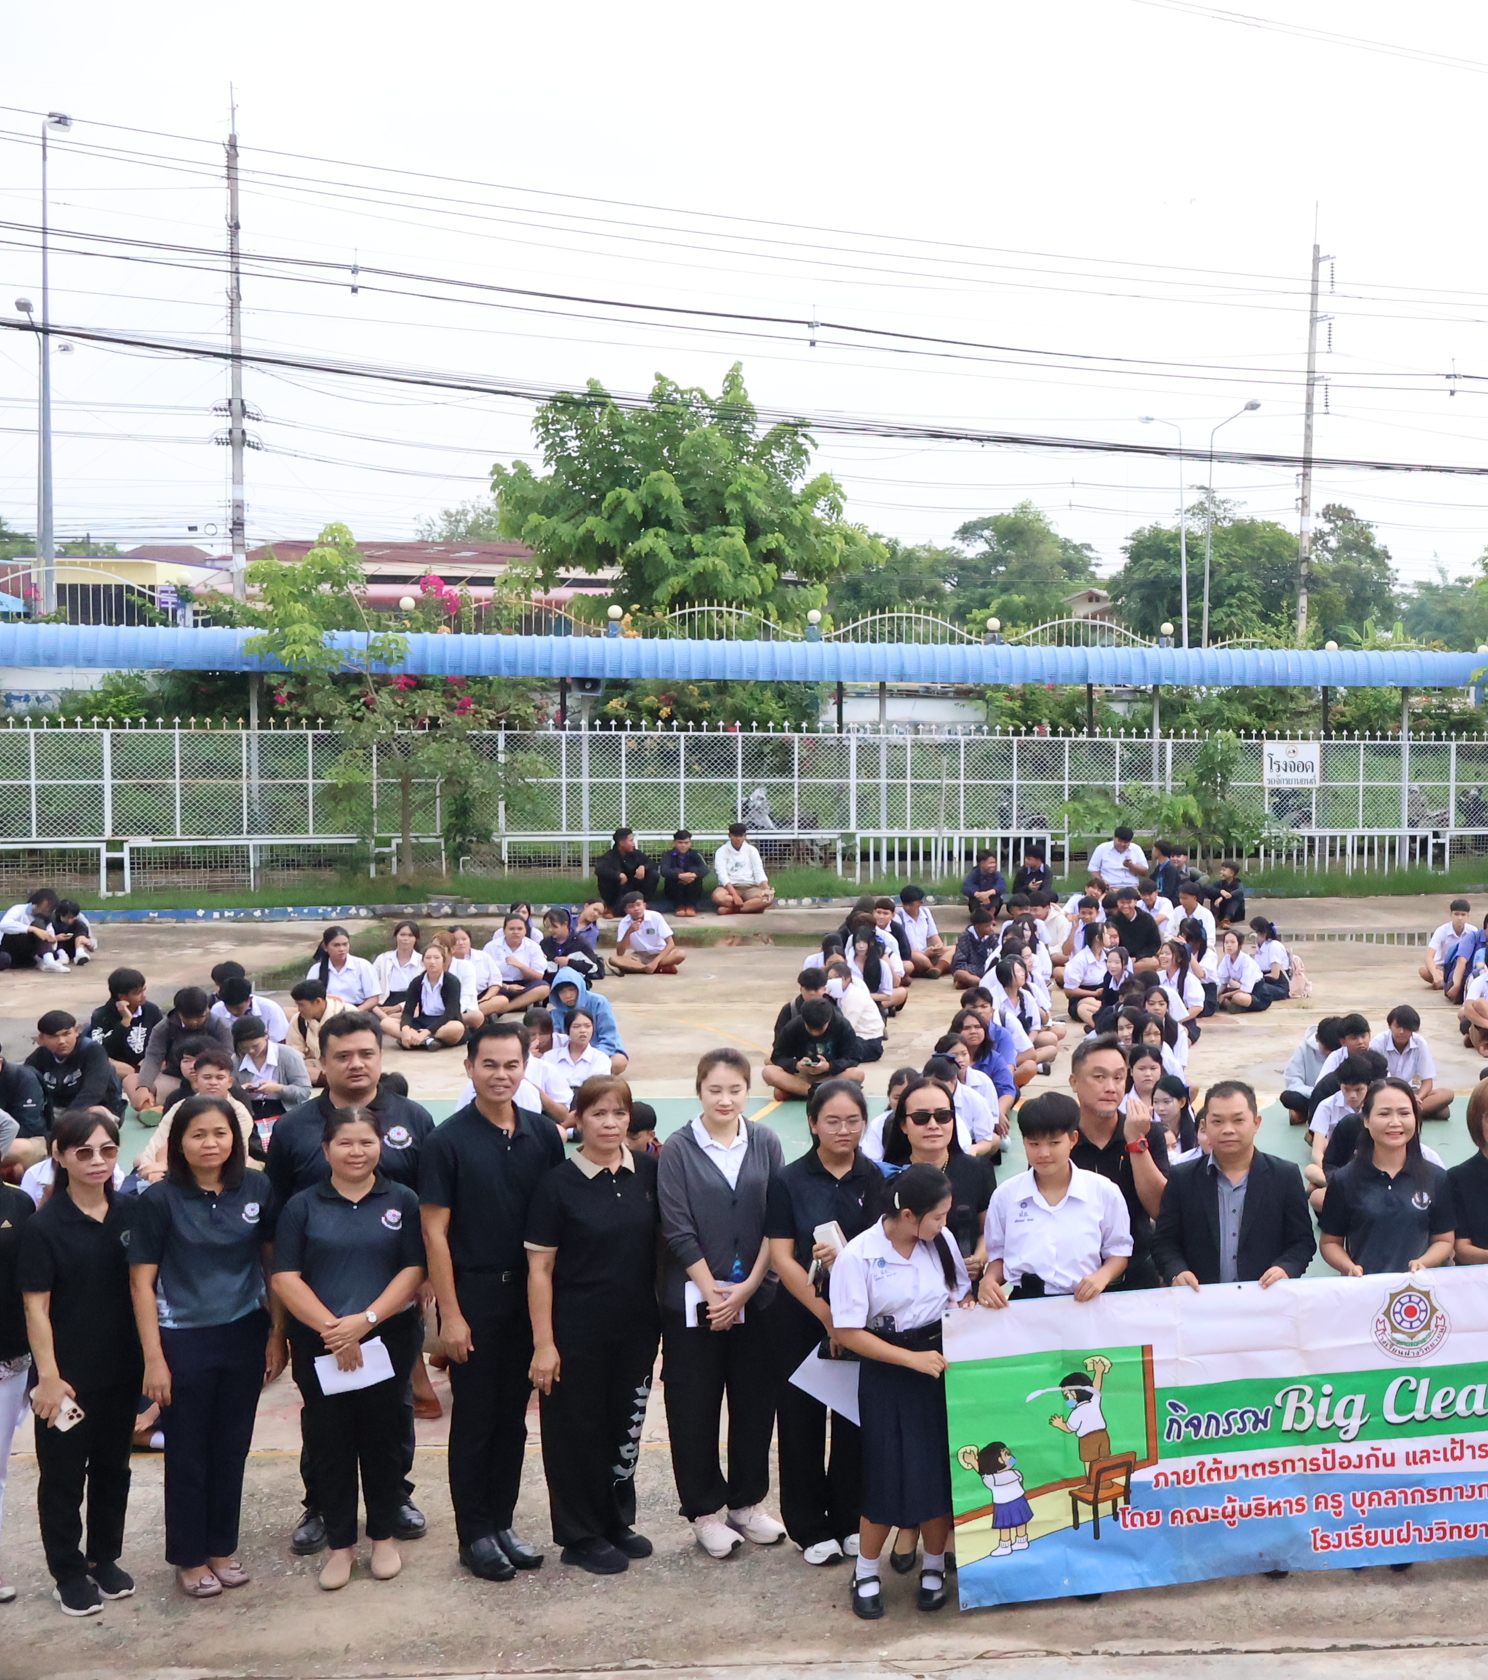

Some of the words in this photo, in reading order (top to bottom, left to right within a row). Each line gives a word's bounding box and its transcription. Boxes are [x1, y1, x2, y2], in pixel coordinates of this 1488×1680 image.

[1267, 753, 1315, 773] โรงจอด
[1165, 1400, 1272, 1441] กิจกรรม
[1274, 1384, 1371, 1442] Big
[1153, 1447, 1396, 1489] ภายใต้มาตรการป้องกัน
[1118, 1506, 1162, 1529] โดย
[1170, 1495, 1307, 1528] คณะผู้บริหาร
[1314, 1493, 1344, 1517] ครู
